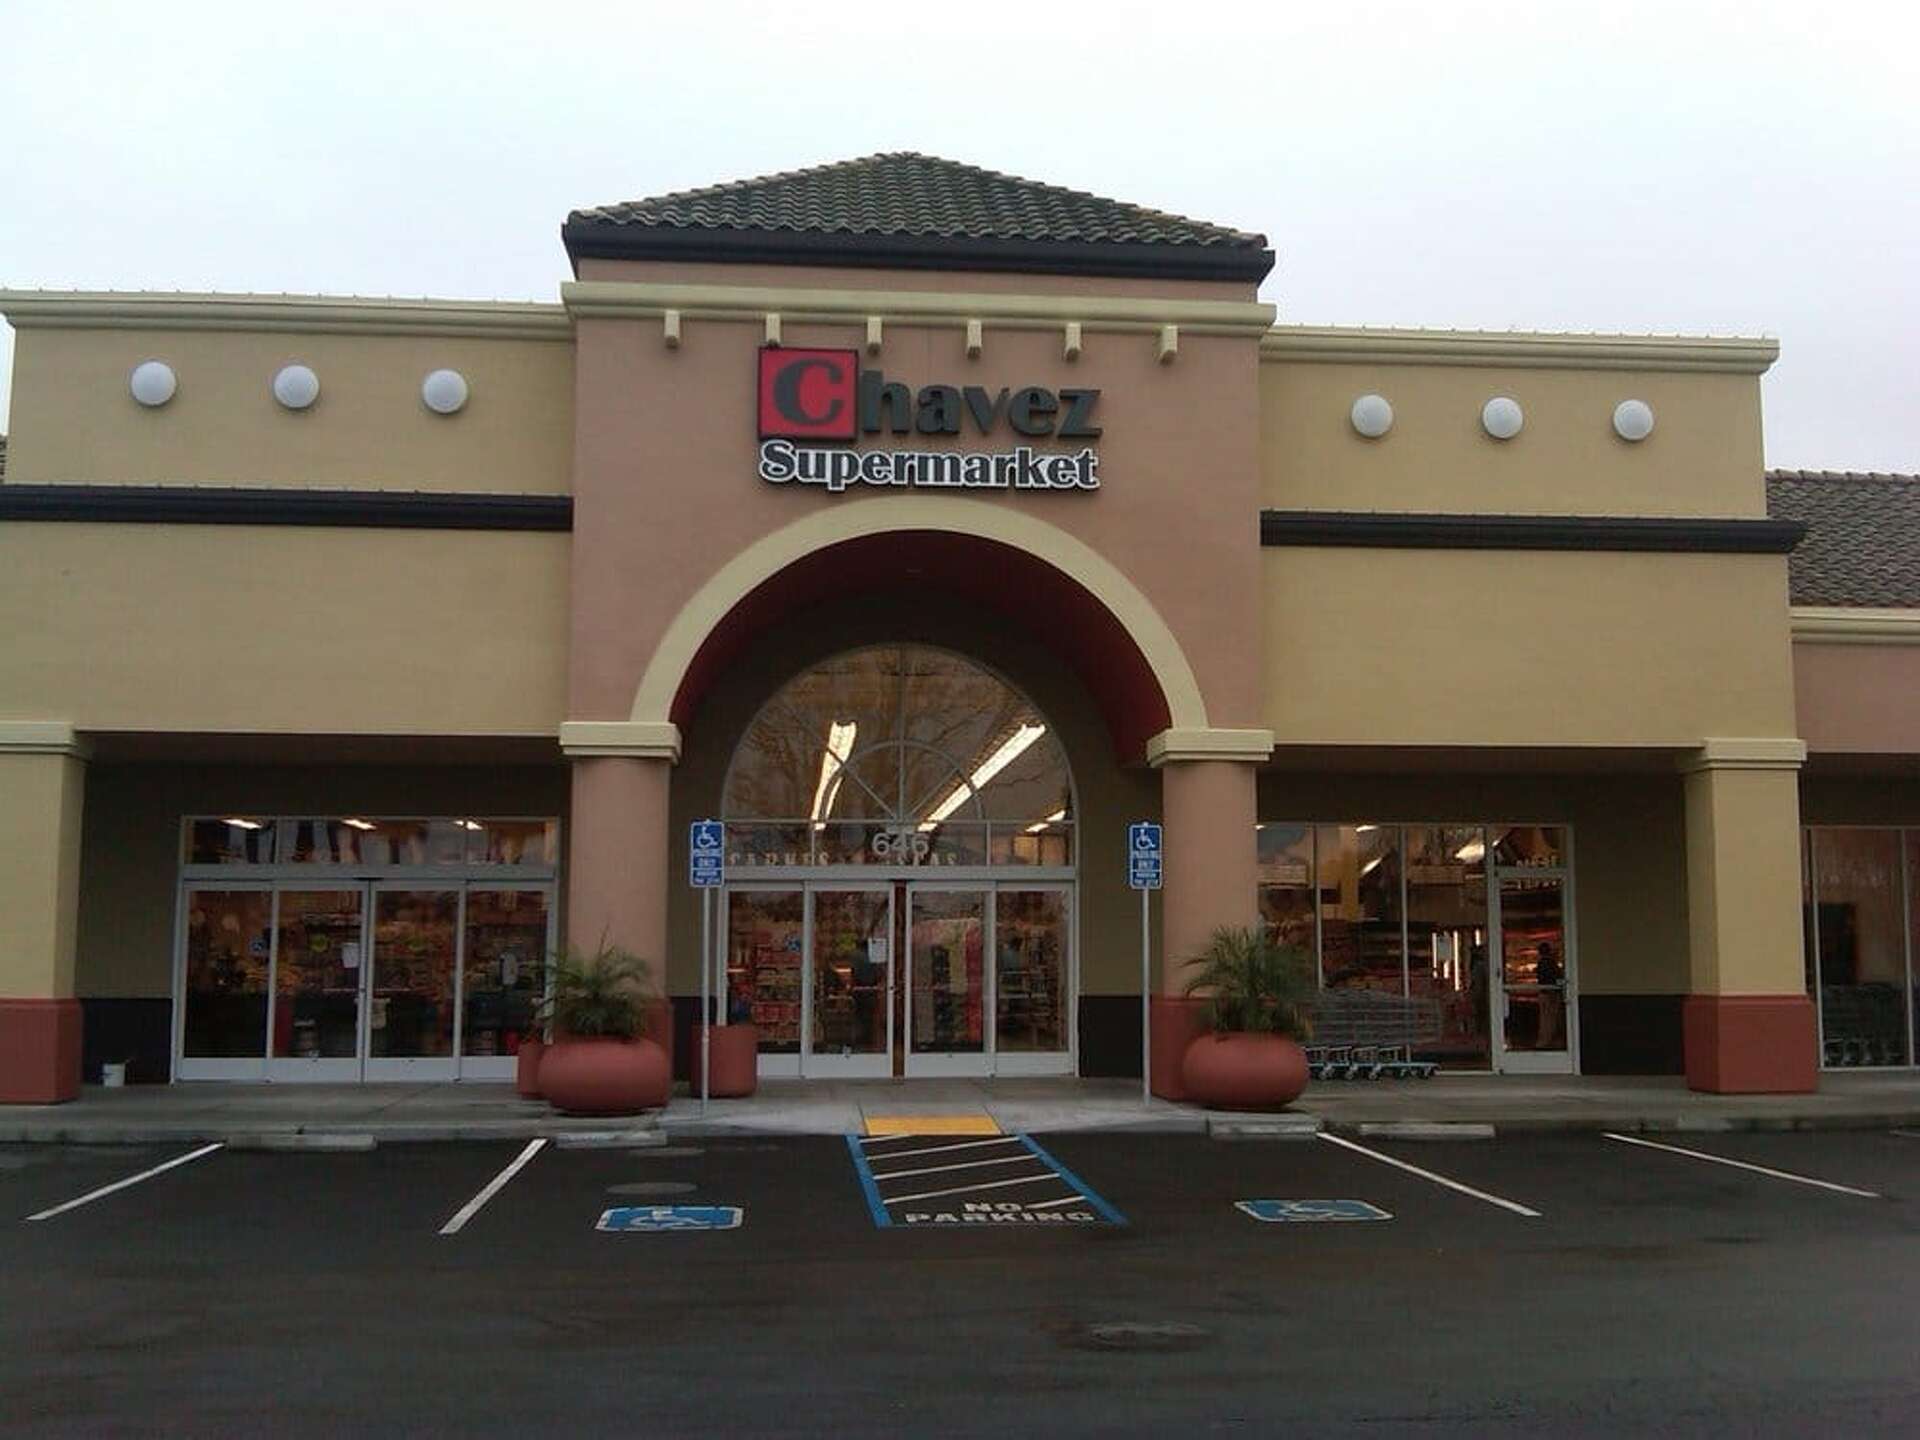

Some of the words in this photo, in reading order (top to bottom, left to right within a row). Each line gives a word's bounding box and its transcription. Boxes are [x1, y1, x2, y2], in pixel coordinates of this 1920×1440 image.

[772, 357, 1102, 438] Chavez
[759, 439, 1100, 491] Supermarket
[871, 832, 929, 856] 646
[905, 1212, 1095, 1223] PARKING
[964, 1202, 1022, 1213] NO
